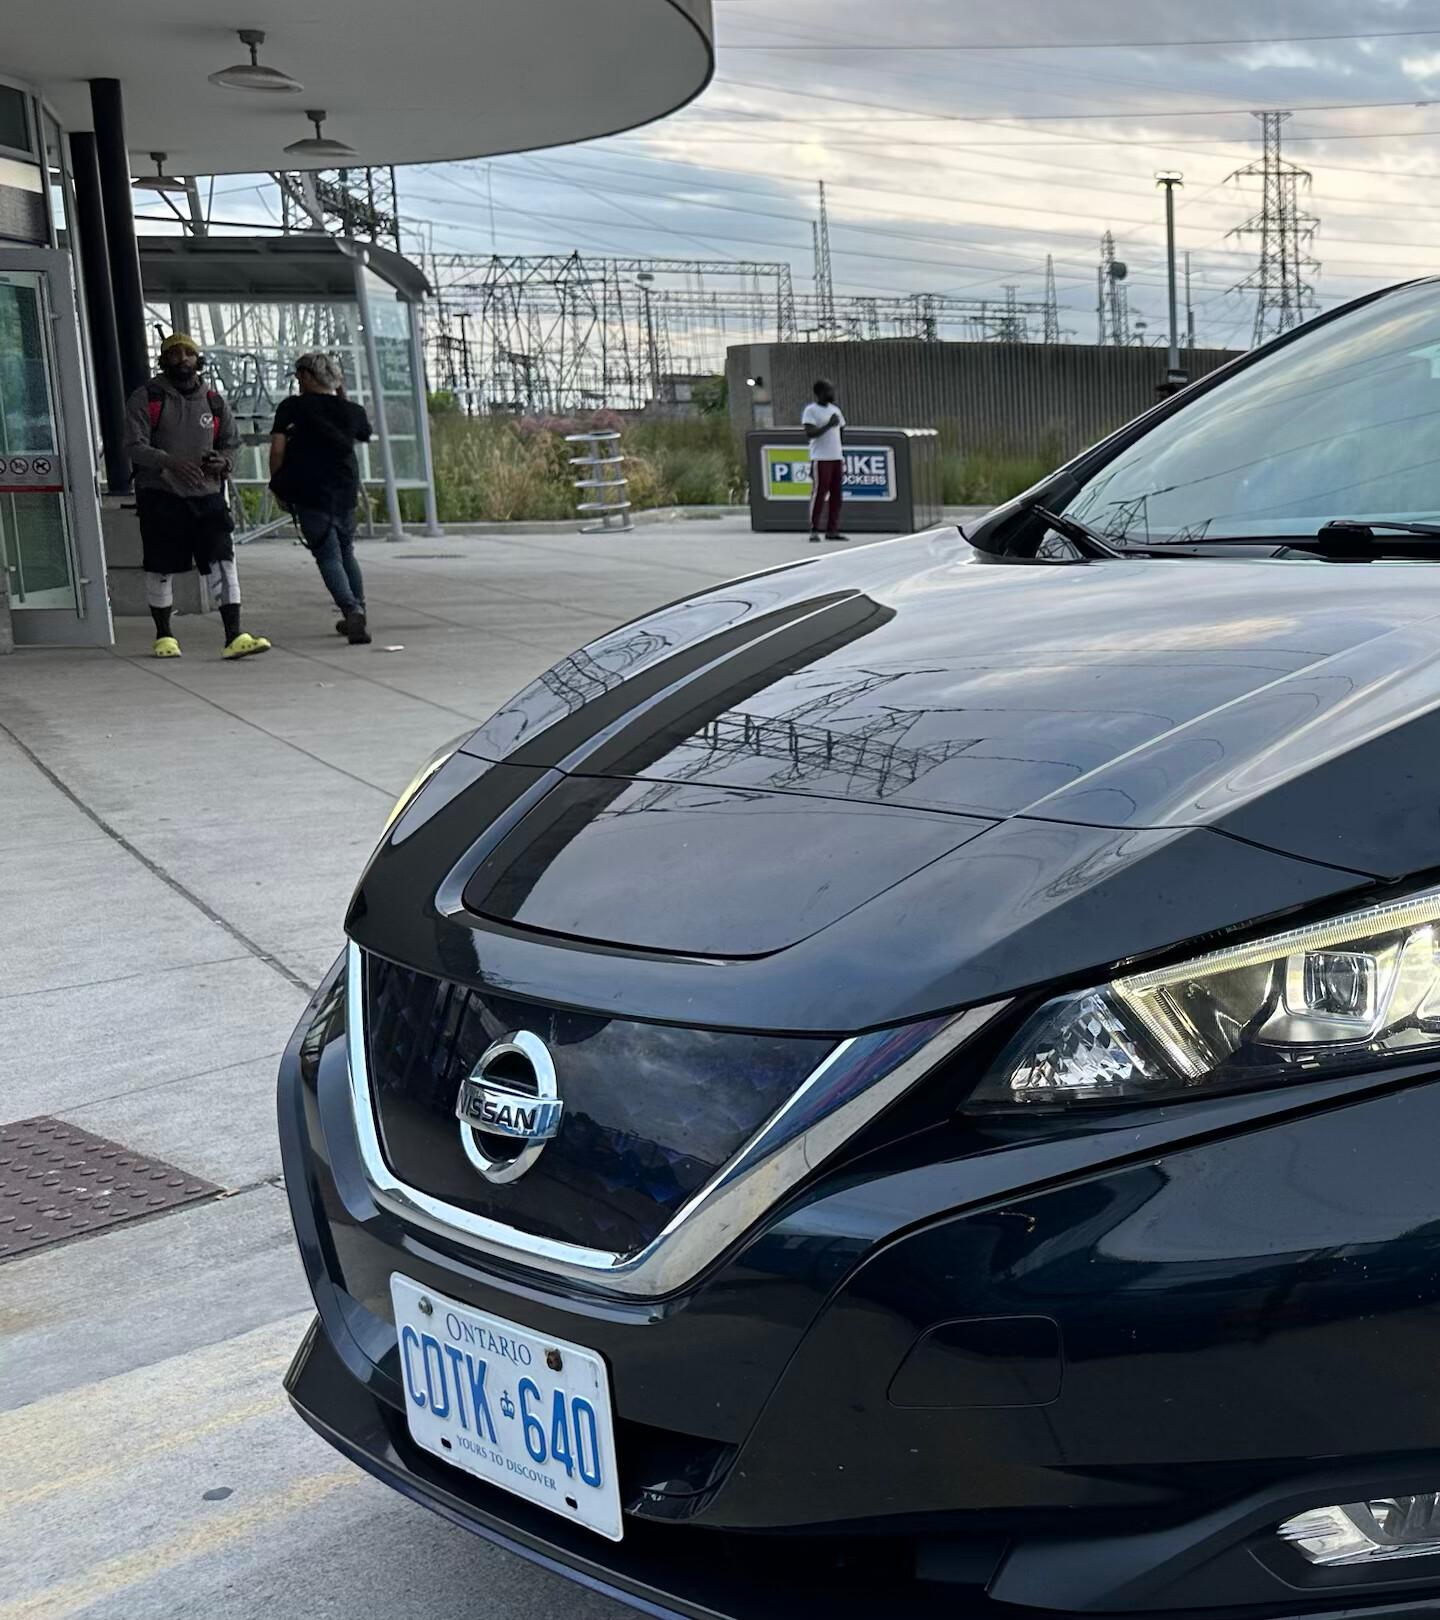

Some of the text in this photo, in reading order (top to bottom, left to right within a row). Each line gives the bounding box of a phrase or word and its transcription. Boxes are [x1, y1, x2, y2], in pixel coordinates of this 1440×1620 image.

[774, 464, 789, 482] P
[841, 474, 887, 486] OCKERS
[459, 1088, 537, 1130] NISSAN
[446, 1313, 532, 1366] ONTARIO
[402, 1325, 603, 1489] CDTK 640
[456, 1434, 557, 1490] YOURS TO DISCOVER
